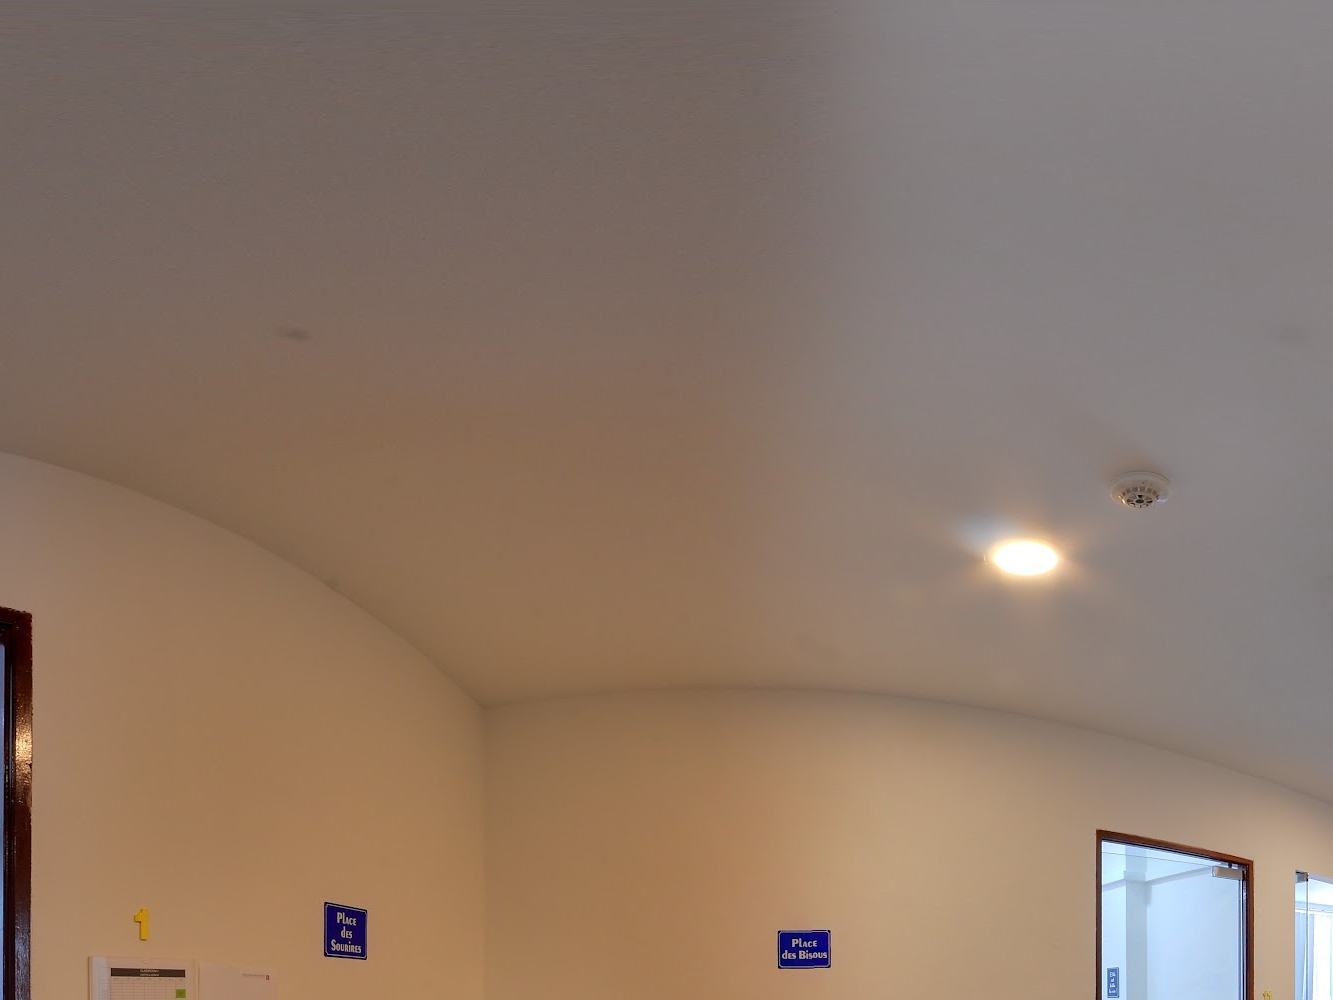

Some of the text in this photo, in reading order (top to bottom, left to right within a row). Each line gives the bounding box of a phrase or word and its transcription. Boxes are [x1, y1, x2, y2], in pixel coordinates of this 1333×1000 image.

[134, 908, 149, 941] 1
[337, 912, 357, 926] Place
[340, 926, 353, 939] des
[331, 939, 362, 953] Sourires
[791, 938, 818, 948] Place
[781, 949, 828, 960] des Bisous
